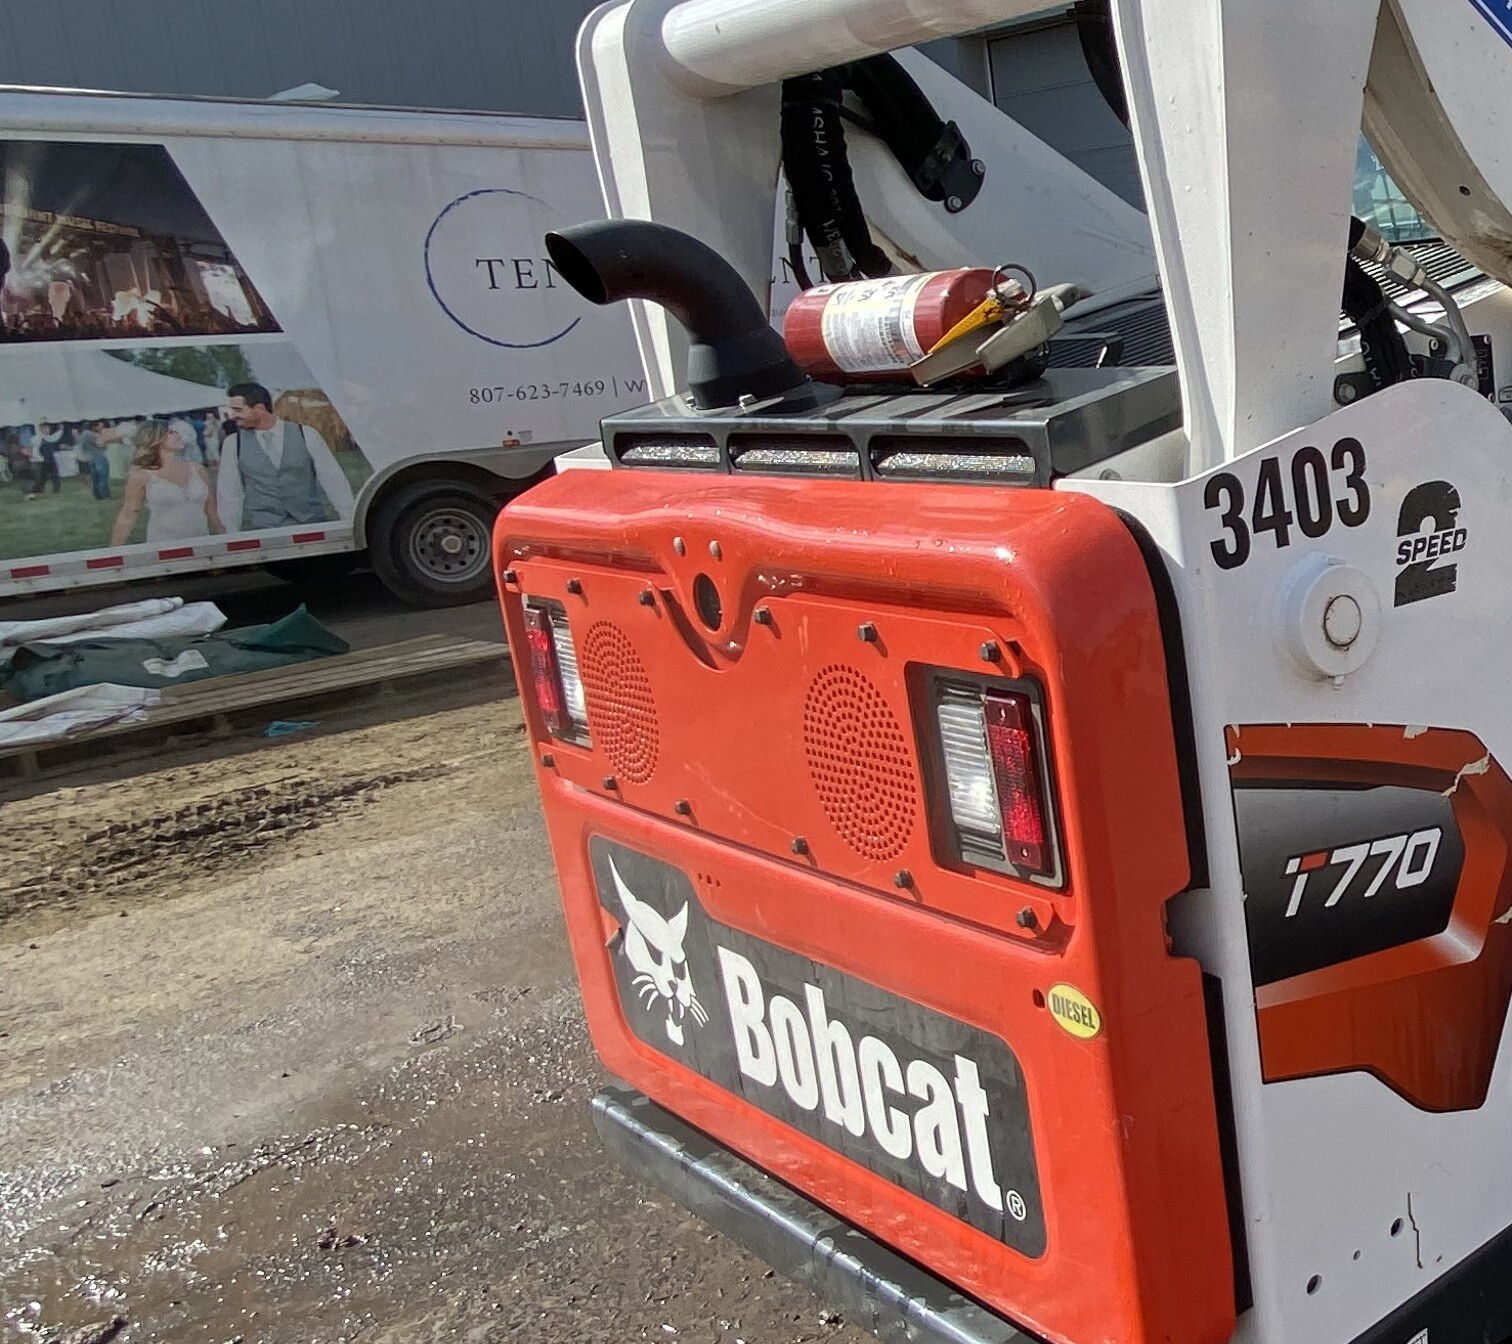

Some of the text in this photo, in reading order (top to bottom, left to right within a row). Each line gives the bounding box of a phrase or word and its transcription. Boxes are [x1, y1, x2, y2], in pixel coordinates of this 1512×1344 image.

[469, 379, 605, 404] 807-623-7469
[1204, 437, 1370, 570] 3403
[1396, 528, 1467, 565] SPEED
[1285, 827, 1442, 918] T770
[1052, 993, 1096, 1030] DIESEL
